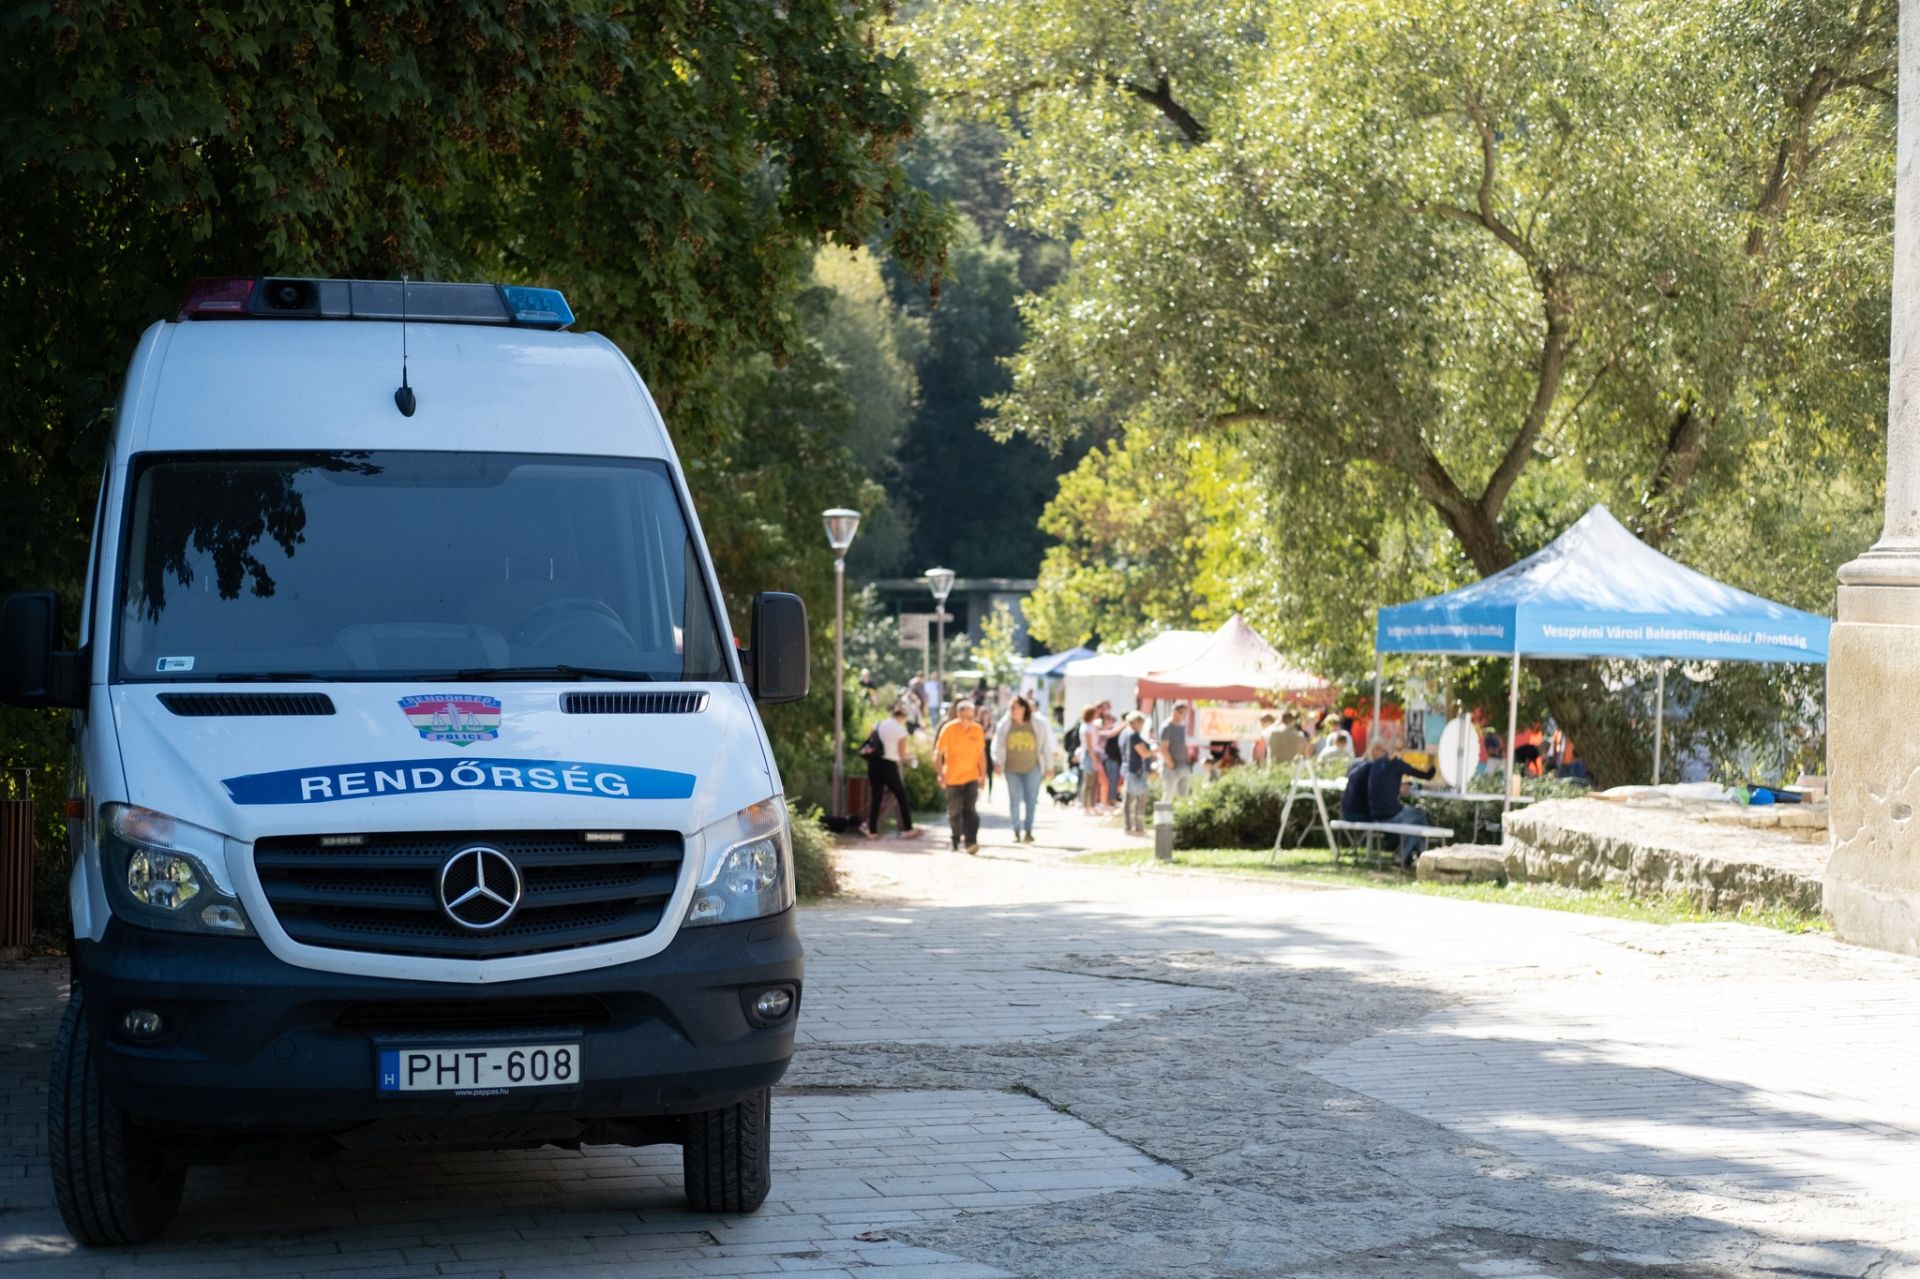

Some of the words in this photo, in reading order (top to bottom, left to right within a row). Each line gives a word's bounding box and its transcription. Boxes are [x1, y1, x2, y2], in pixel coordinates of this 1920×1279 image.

[1542, 624, 1603, 640] Veszprémi
[1606, 625, 1642, 639] Városi
[300, 760, 630, 800] RENDŐRSÉG
[408, 1048, 572, 1086] PHT-608
[384, 1073, 394, 1085] H
[455, 1088, 510, 1096] www.pappas.hu
